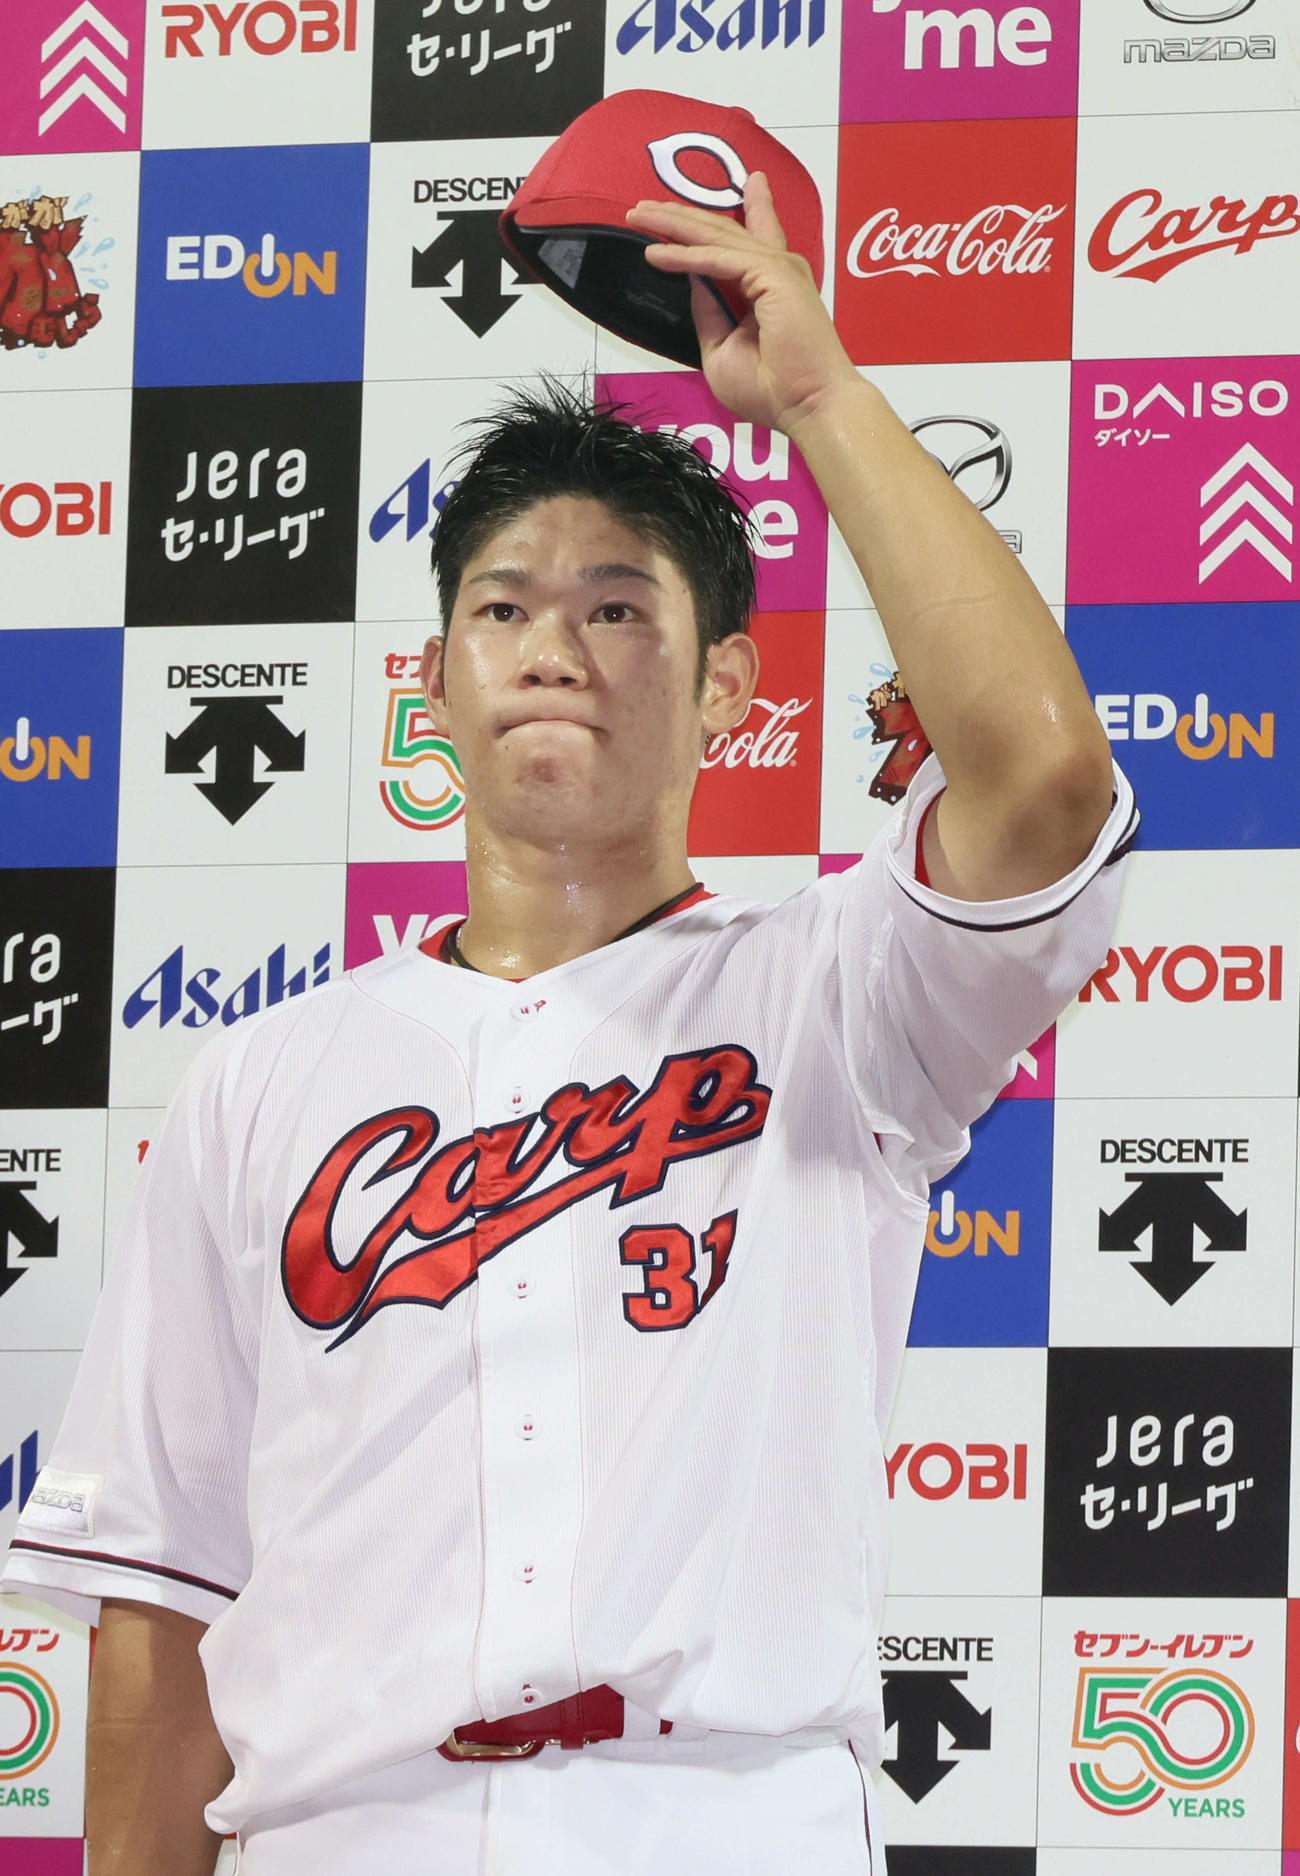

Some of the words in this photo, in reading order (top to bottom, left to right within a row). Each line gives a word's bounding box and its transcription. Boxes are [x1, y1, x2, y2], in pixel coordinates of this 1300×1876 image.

[163, 0, 357, 58] RYOBI
[904, 6, 1052, 70] me
[413, 176, 528, 203] DESCEN
[847, 203, 1068, 278] Coca-Cola
[1087, 188, 1300, 283] Carp
[1094, 428, 1171, 448] ダイソー
[0, 481, 112, 539] OBI
[167, 662, 309, 689] DESCENTE
[1100, 1138, 1250, 1164] DESCENTE
[280, 1043, 773, 1354] Carp
[618, 1207, 739, 1333] 31
[1069, 1666, 1256, 1817] 50
[1167, 1797, 1246, 1819] YEARS
